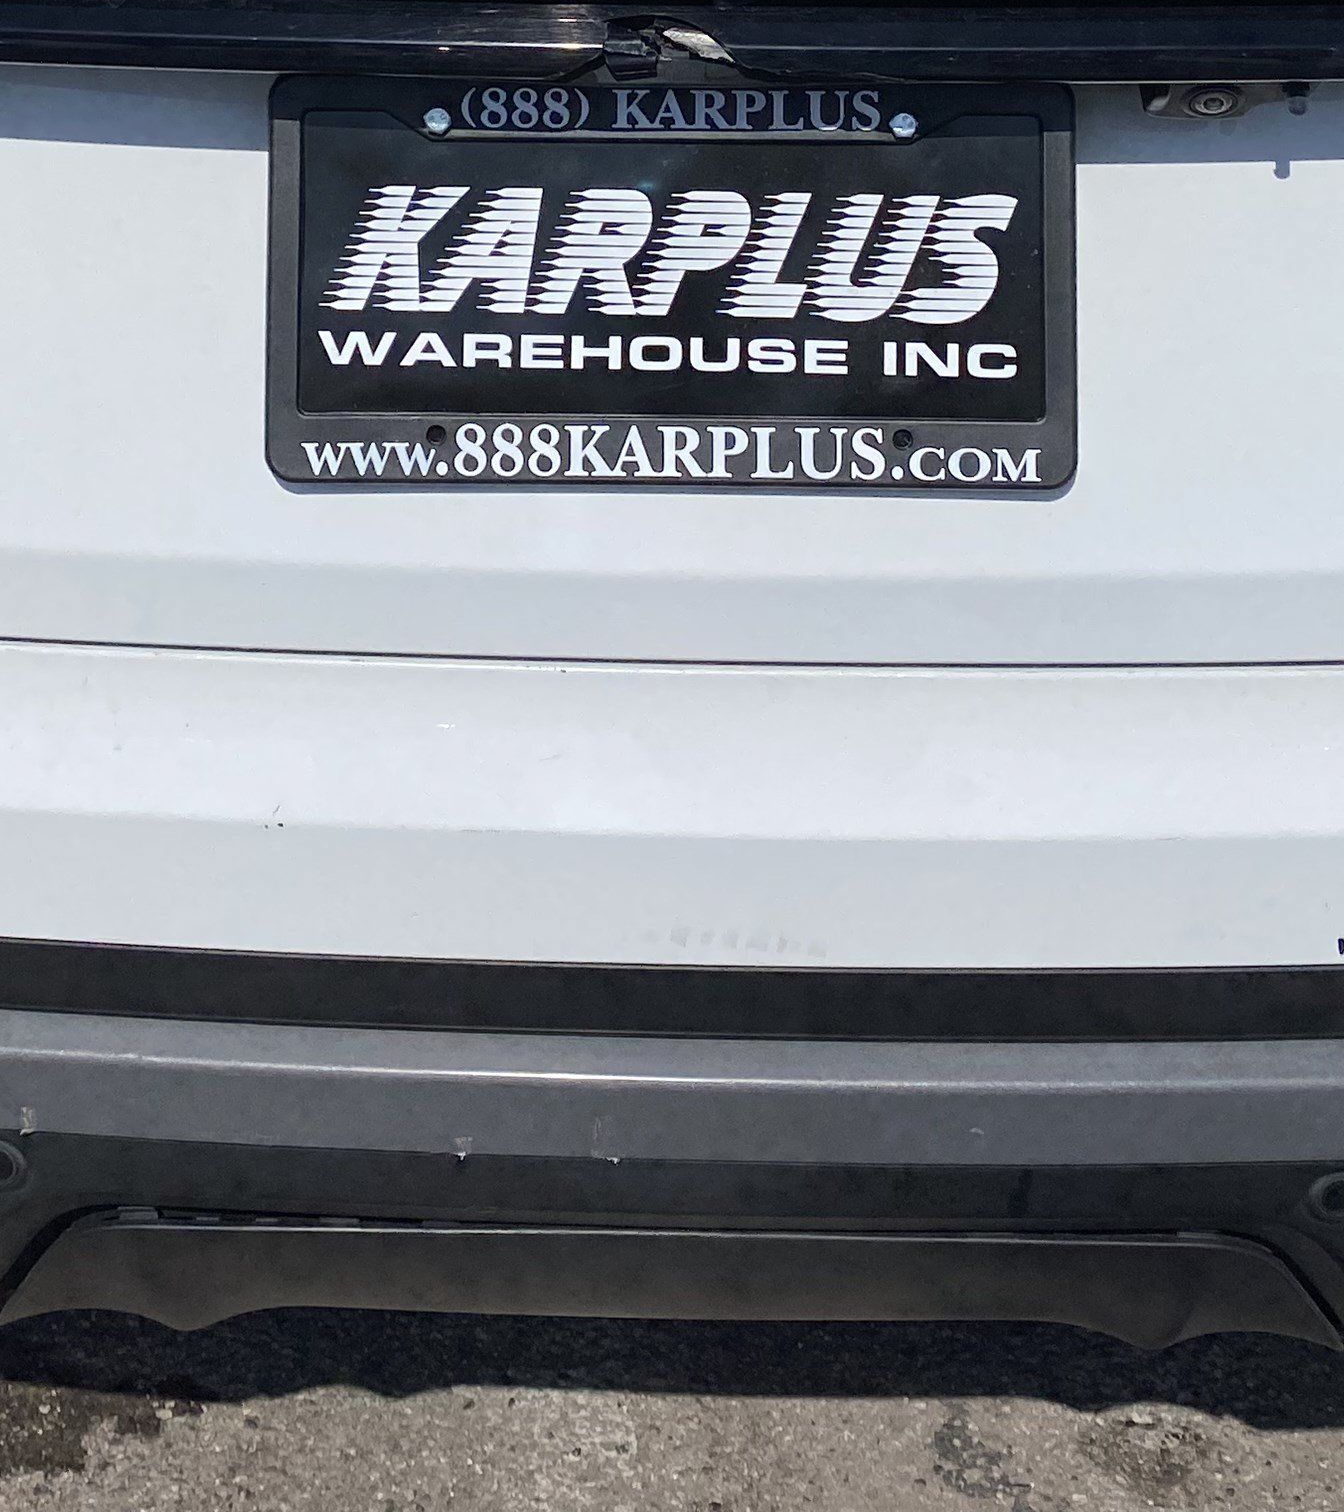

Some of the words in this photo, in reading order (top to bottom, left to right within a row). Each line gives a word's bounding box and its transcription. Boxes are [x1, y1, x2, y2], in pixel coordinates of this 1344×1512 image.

[460, 87, 589, 131] (888)
[612, 88, 881, 133] KARPLUS
[318, 183, 1019, 326] KARPLUS
[317, 329, 849, 377] WAREHOUSE
[881, 340, 1019, 380] INC
